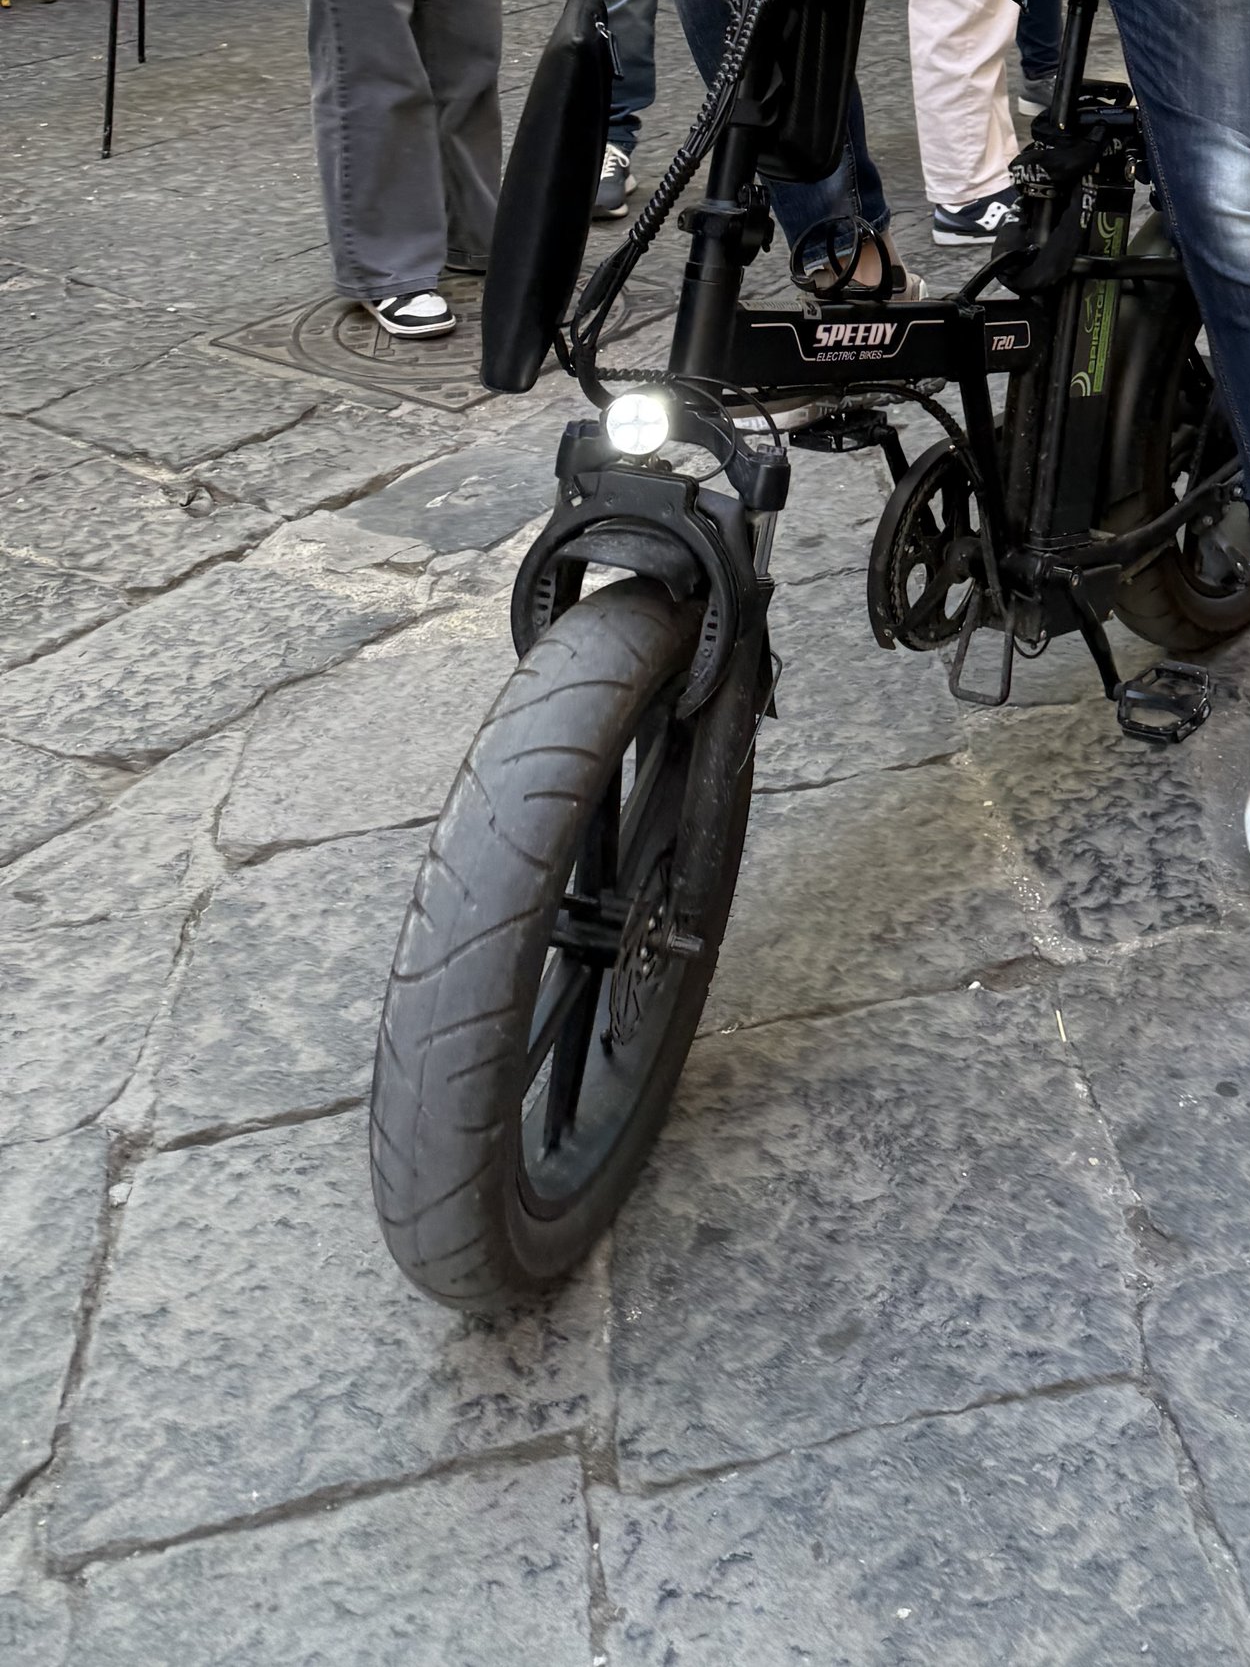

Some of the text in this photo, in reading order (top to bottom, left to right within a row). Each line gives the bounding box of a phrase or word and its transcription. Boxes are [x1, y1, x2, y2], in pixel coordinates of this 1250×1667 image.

[813, 322, 898, 348] SPEEDY
[991, 335, 1015, 351] T20
[816, 350, 883, 363] ELECTRIC BIKES
